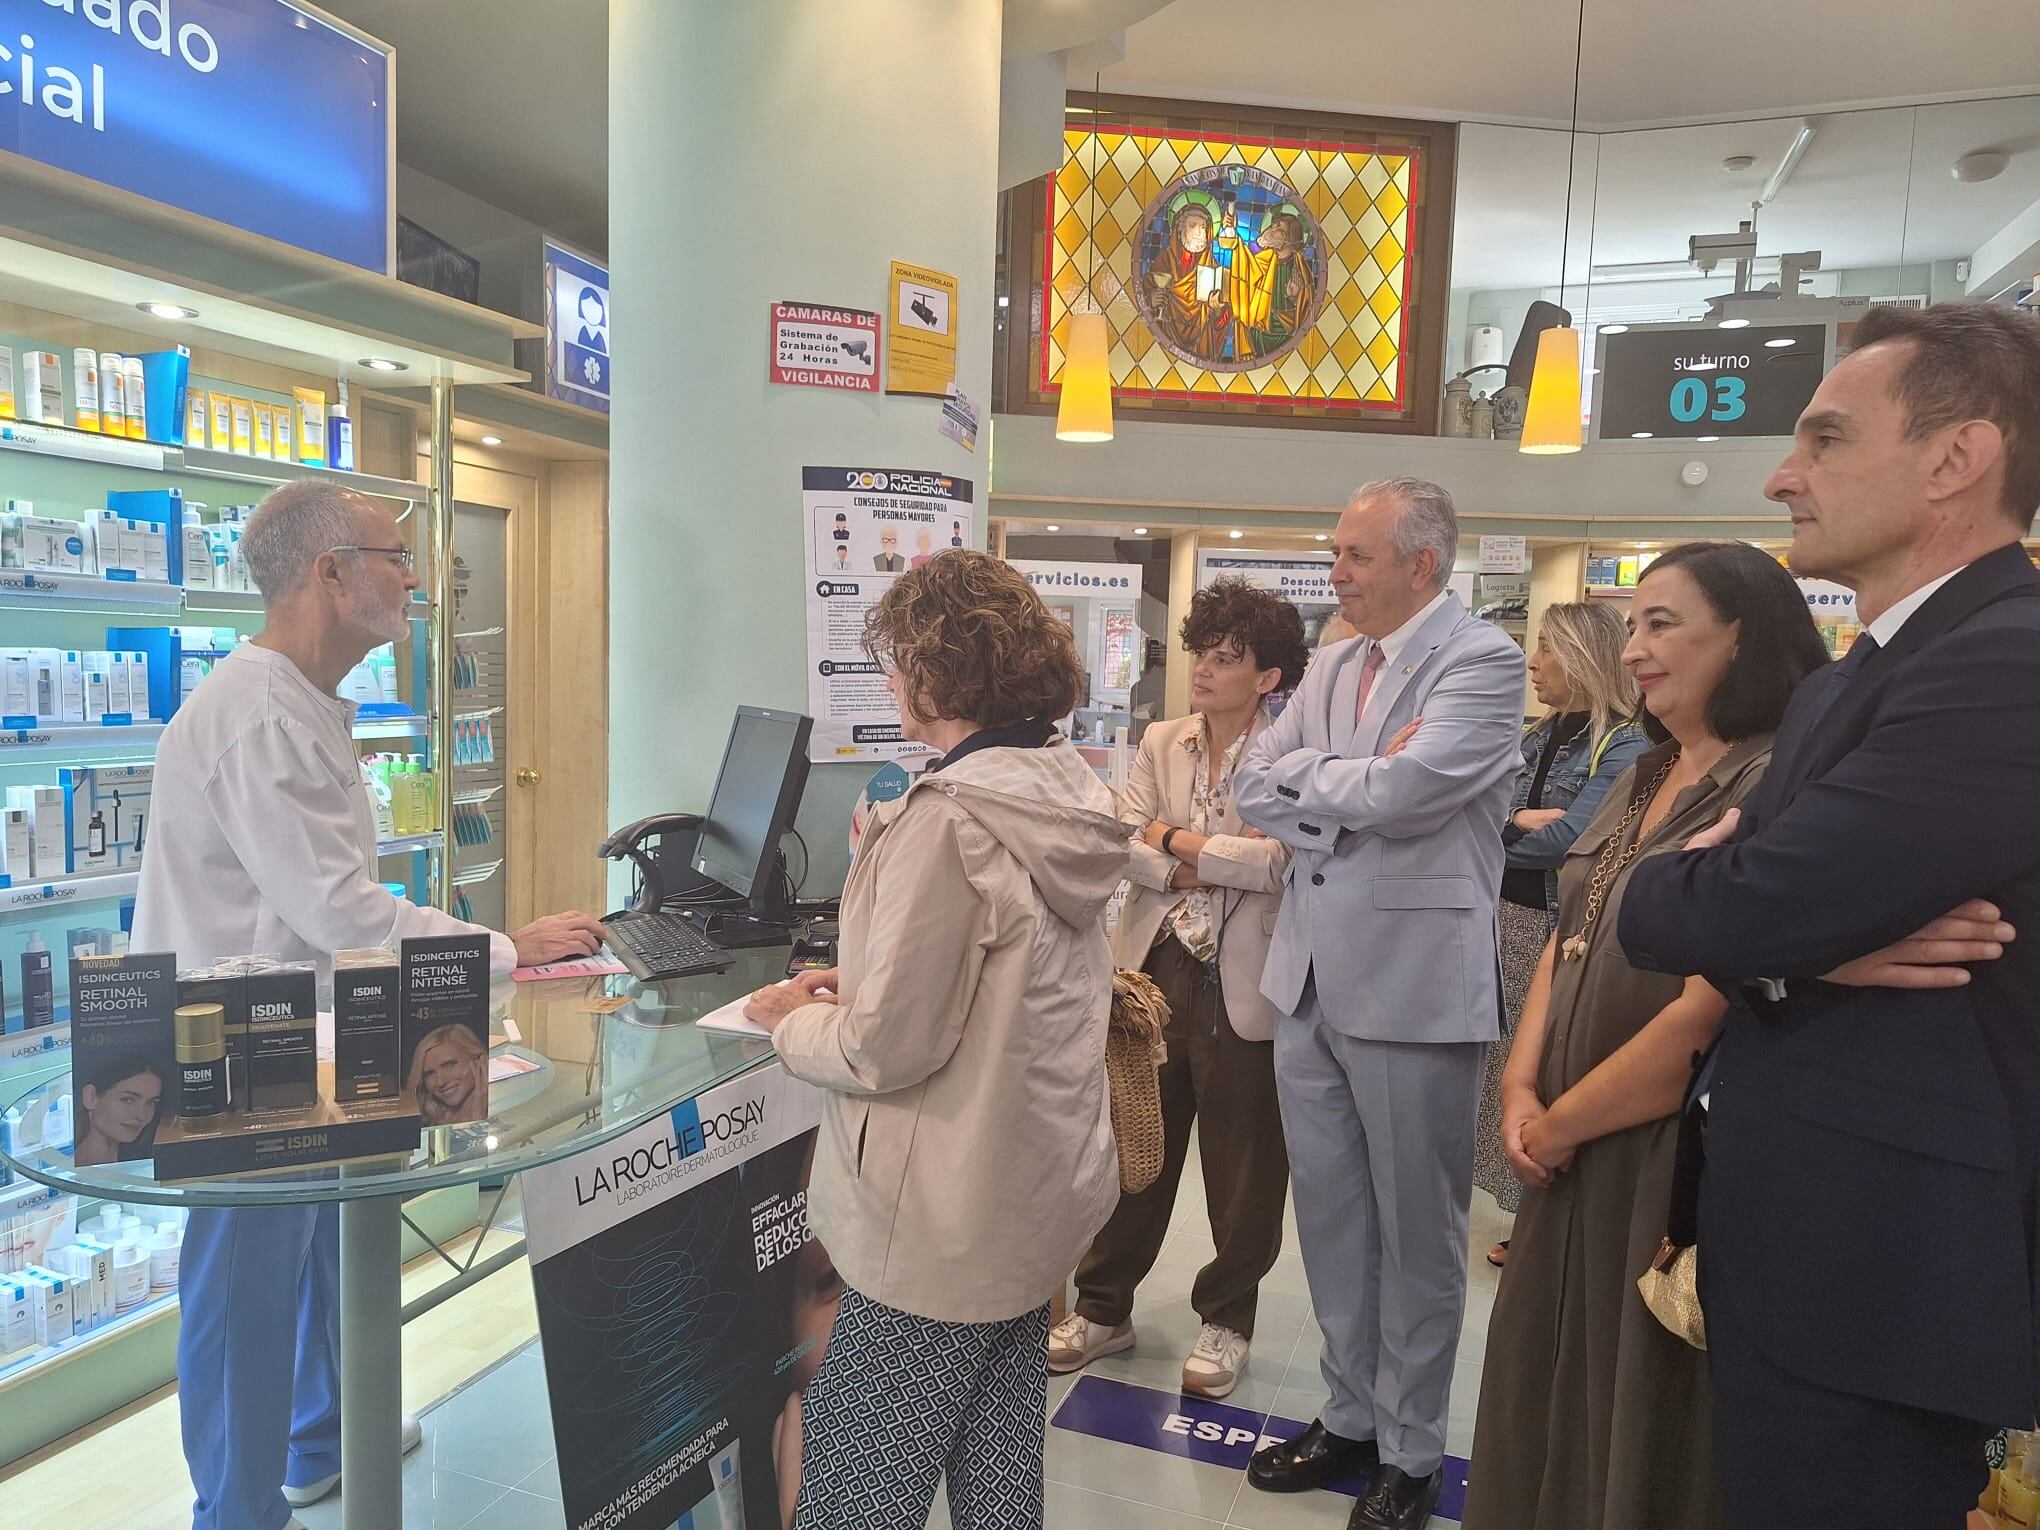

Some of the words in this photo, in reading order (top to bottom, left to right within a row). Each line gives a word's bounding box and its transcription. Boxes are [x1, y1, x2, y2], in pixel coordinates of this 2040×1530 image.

[42, 0, 220, 74] ado
[895, 267, 912, 278] ZONA
[913, 271, 953, 288] VIDEOVIGILADA
[776, 306, 852, 325] CAMARAS
[857, 314, 876, 327] DE
[780, 329, 823, 341] Sistema
[826, 332, 839, 341] de
[780, 340, 839, 353] Grabación
[780, 352, 794, 362] 24
[803, 354, 839, 365] Horas
[1673, 356, 1695, 371] su
[1699, 353, 1750, 370] turno
[781, 370, 871, 389] VIGILANCIA
[1669, 376, 1746, 422] 03
[890, 473, 941, 487] POLICIA
[890, 482, 952, 497] NACIONAL
[854, 497, 889, 508] CONSEJOS
[890, 498, 898, 508] DE
[899, 499, 933, 512] SEGURIDAD
[933, 503, 948, 513] PARA
[872, 510, 907, 521] PERSONAS
[907, 512, 936, 522] MAYORES
[841, 586, 856, 594] CASA
[1270, 588, 1323, 597] uestros
[12, 895, 23, 904] LA
[53, 887, 77, 897] POSAY
[82, 959, 120, 969] NOVEDAD
[410, 950, 480, 963] ISDINCEUTICS
[79, 970, 161, 984] ISDINCEUTICS
[411, 965, 467, 978] RETINAL
[411, 975, 467, 989] INTENSE
[80, 987, 147, 1000] RETINAL
[353, 985, 382, 997] ISDIN
[80, 998, 148, 1012] SMOOTH
[251, 1003, 292, 1018] ISDIN
[184, 1068, 212, 1080] ISDIN
[287, 1133, 328, 1149] ISDIN
[575, 1166, 611, 1207] LA
[612, 1126, 699, 1190] ROCHE
[700, 1095, 766, 1149] POSAY
[616, 1163, 684, 1206] LABORATOIRE
[684, 1130, 759, 1175] DERMATOLOGIQUE
[750, 1193, 780, 1214] INNOVACIÓN
[752, 1191, 807, 1233] EFFACLAR
[756, 1246, 775, 1273] DE
[775, 1230, 802, 1260] LOS
[802, 1225, 816, 1242] G
[577, 1503, 617, 1530] MARCA
[615, 1486, 638, 1510] MÁS
[637, 1435, 706, 1494] RECOMENDADA
[705, 1417, 729, 1442] PARA
[603, 1507, 626, 1530] CON
[626, 1470, 680, 1517] TENDENCIA
[678, 1441, 716, 1476] ACNEICA
